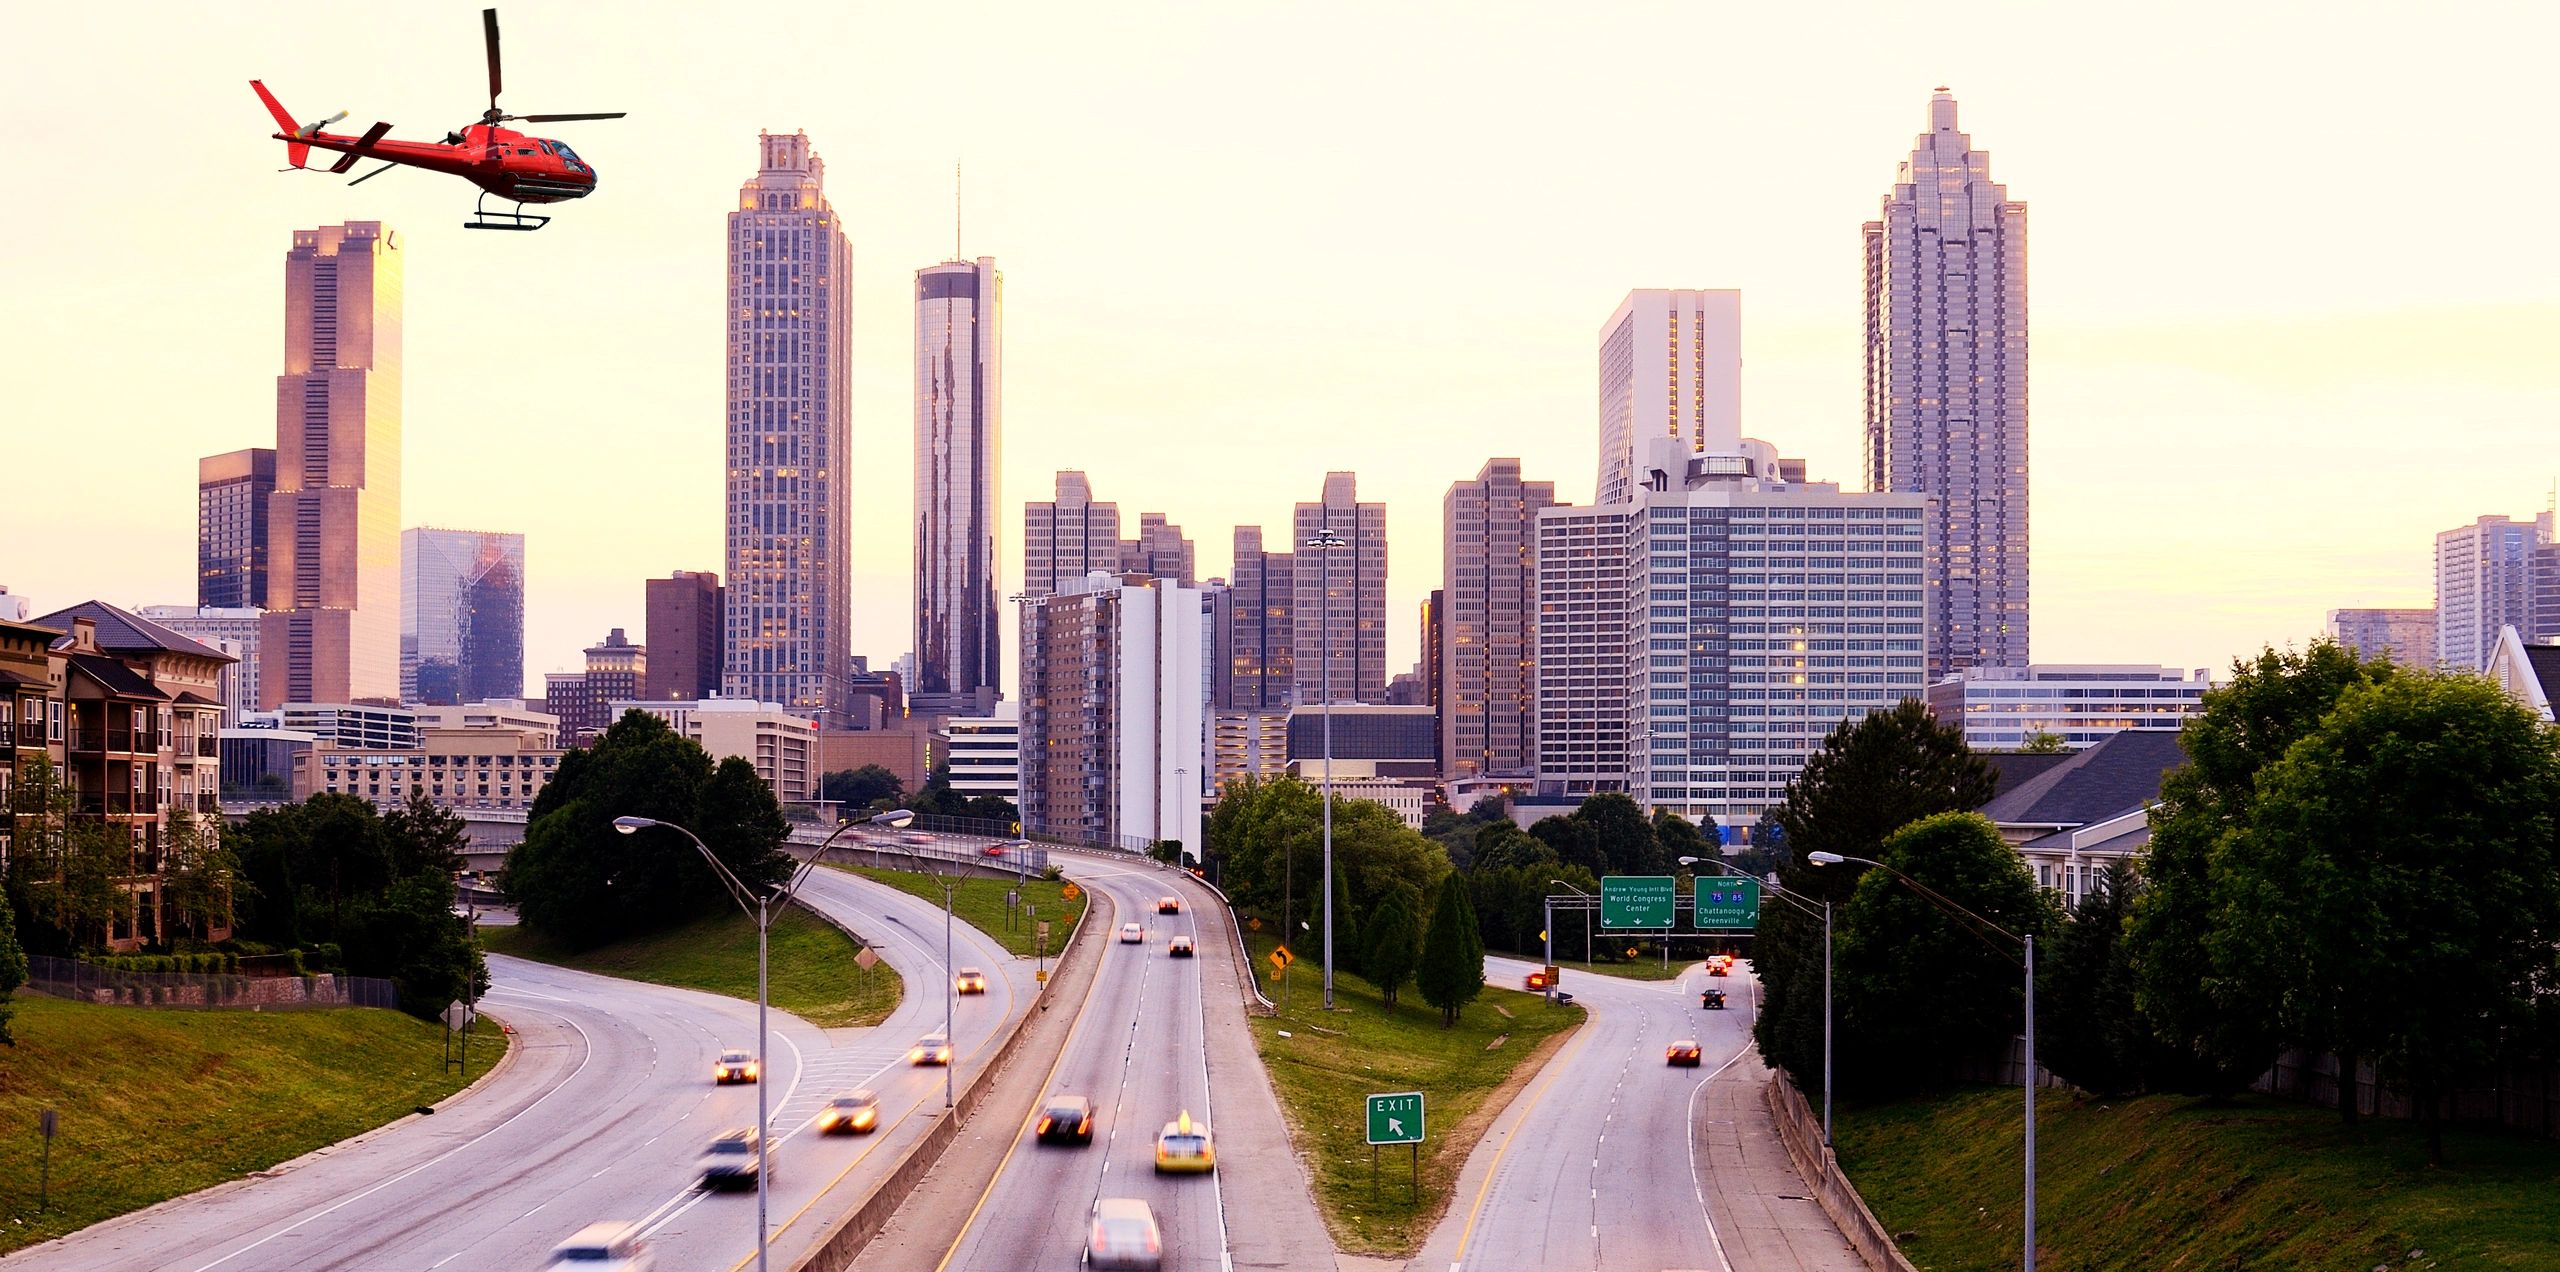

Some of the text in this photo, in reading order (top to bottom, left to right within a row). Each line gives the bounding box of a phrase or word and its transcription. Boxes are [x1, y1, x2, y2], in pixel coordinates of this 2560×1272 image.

[1632, 895, 1666, 904] Congress
[1713, 893, 1722, 901] 75
[1699, 907, 1745, 916] Chattanooga
[1377, 1099, 1413, 1111] EXIT
